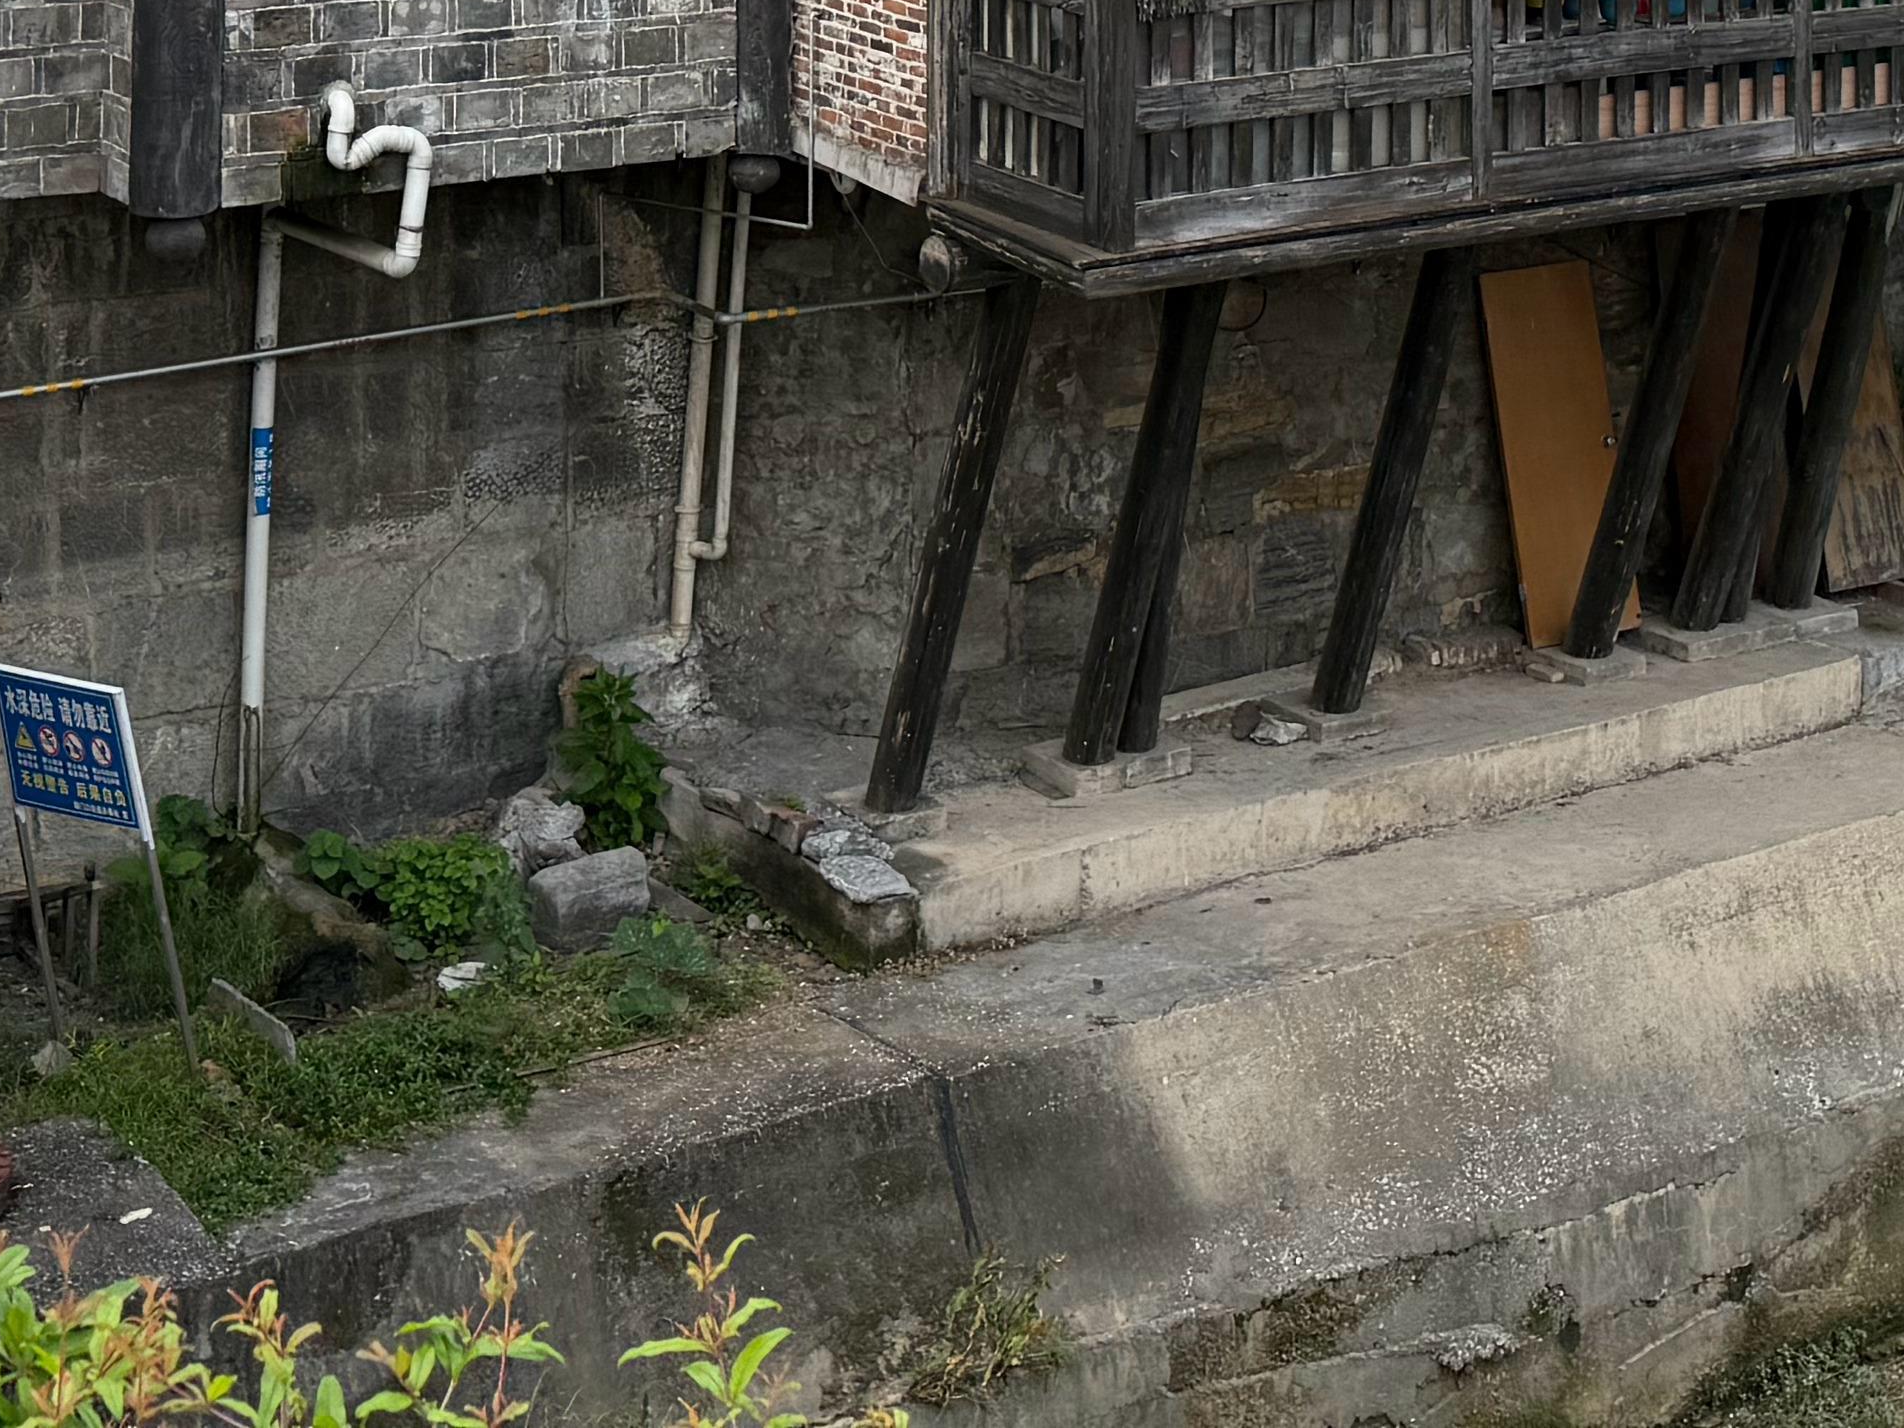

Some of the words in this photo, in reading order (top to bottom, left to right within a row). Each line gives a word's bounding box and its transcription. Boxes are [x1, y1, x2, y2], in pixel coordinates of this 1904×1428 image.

[4, 685, 56, 722] 水深危险
[58, 696, 112, 734] 请勿靠近
[20, 769, 69, 795] 无视警告
[76, 781, 127, 807] 后果自负
